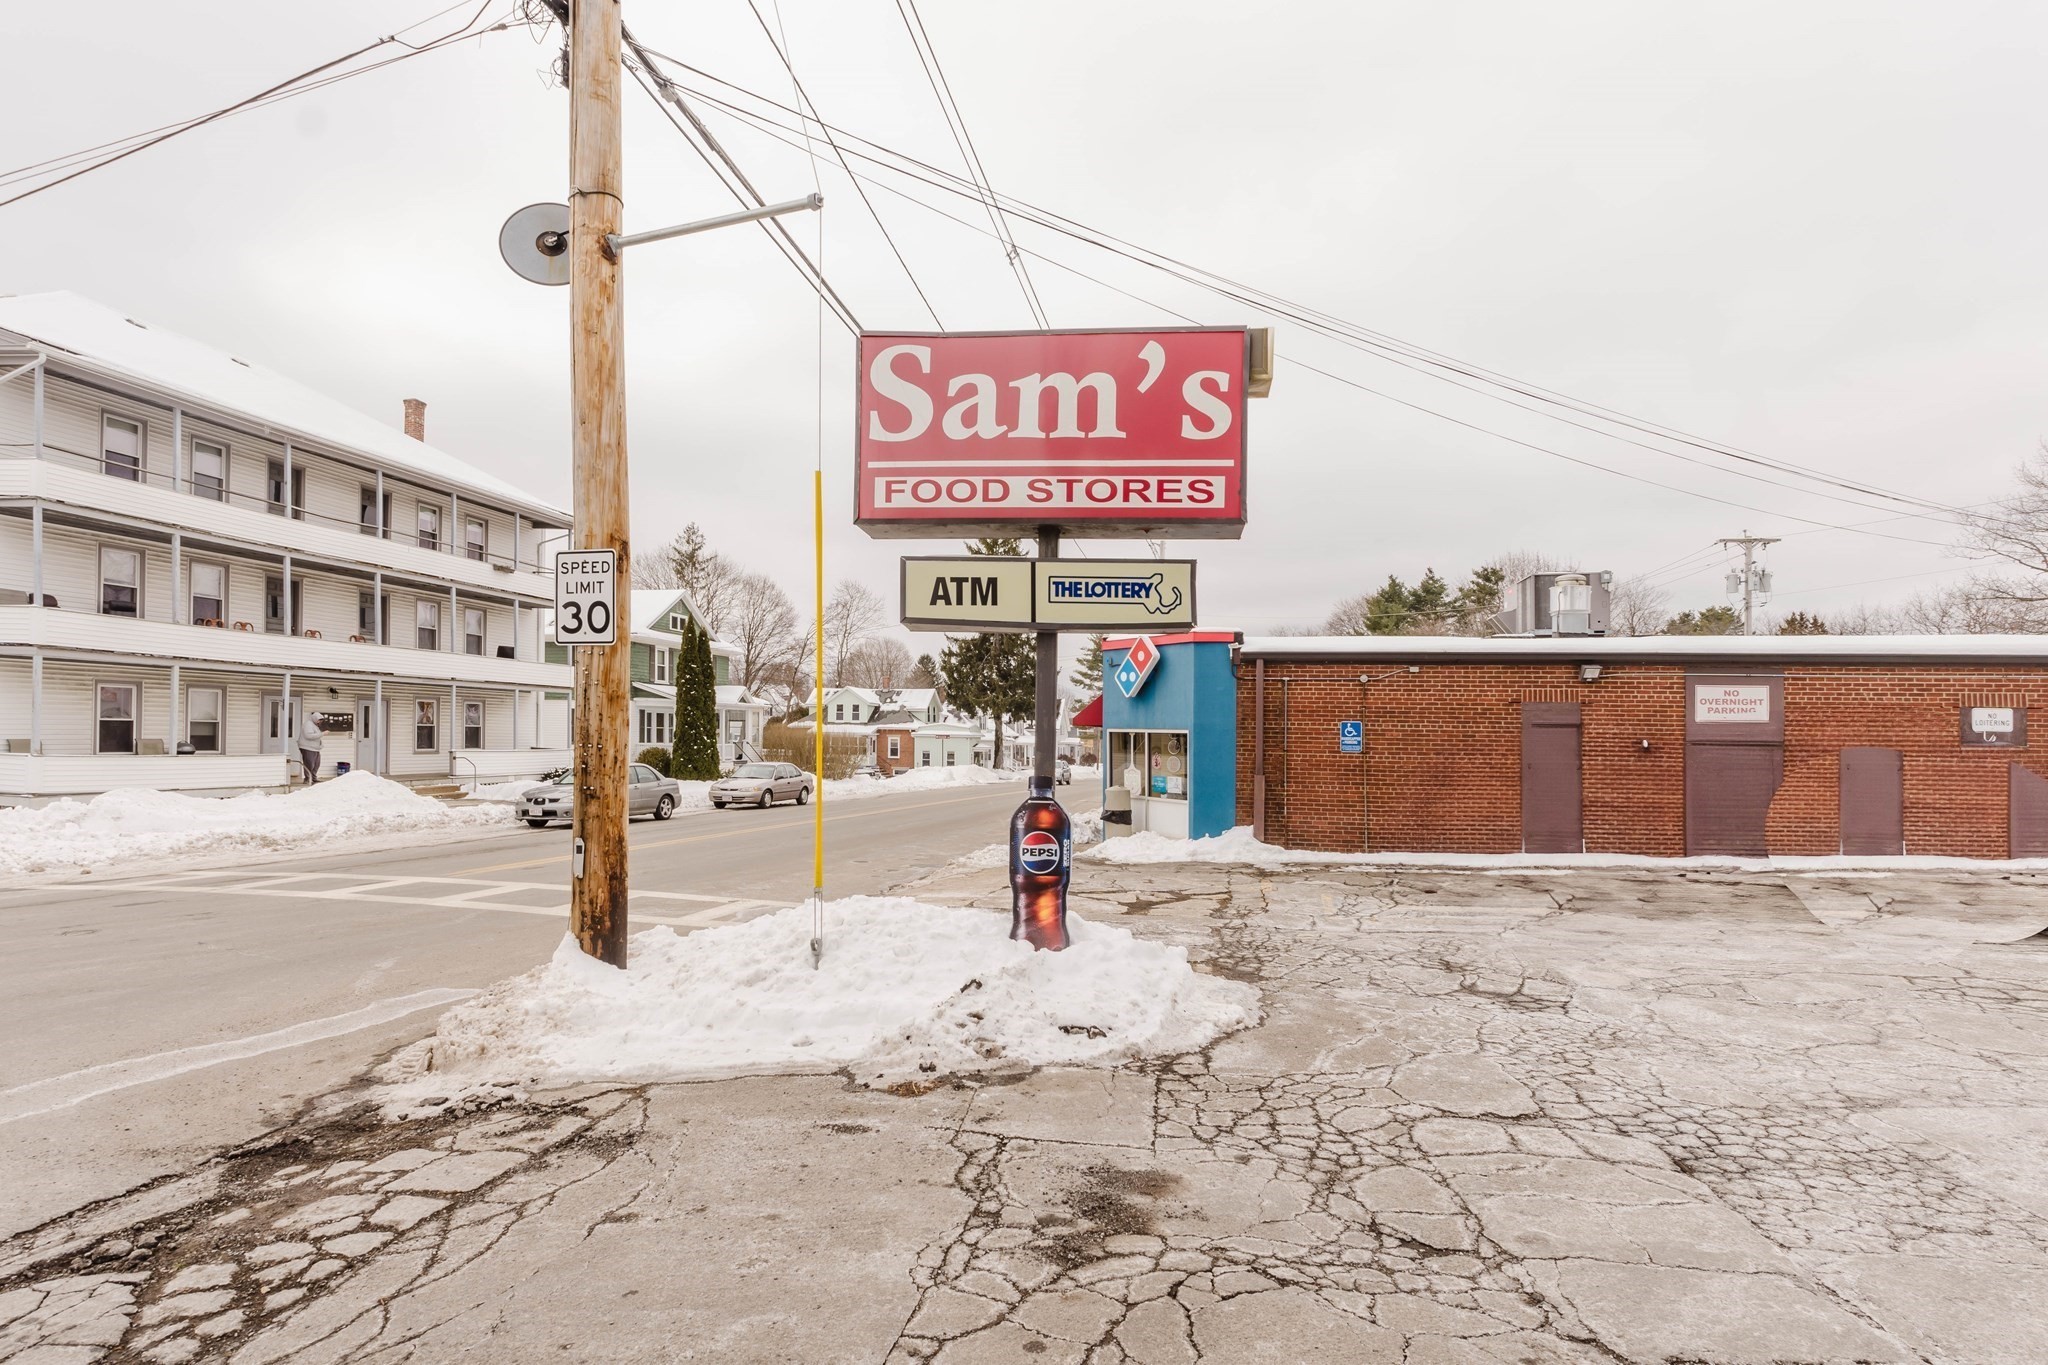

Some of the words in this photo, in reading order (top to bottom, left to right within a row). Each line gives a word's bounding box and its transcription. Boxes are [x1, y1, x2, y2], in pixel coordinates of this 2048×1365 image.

[869, 340, 1232, 442] Sam's
[884, 479, 1011, 503] FOOD
[1026, 478, 1215, 504] STORES
[561, 561, 610, 574] SPEED
[566, 581, 604, 594] LIMIT
[929, 577, 998, 606] ATM
[1052, 581, 1083, 598] THE
[1084, 581, 1154, 598] LOTTERY
[561, 601, 610, 634] 30
[1022, 848, 1057, 857] PEPSI
